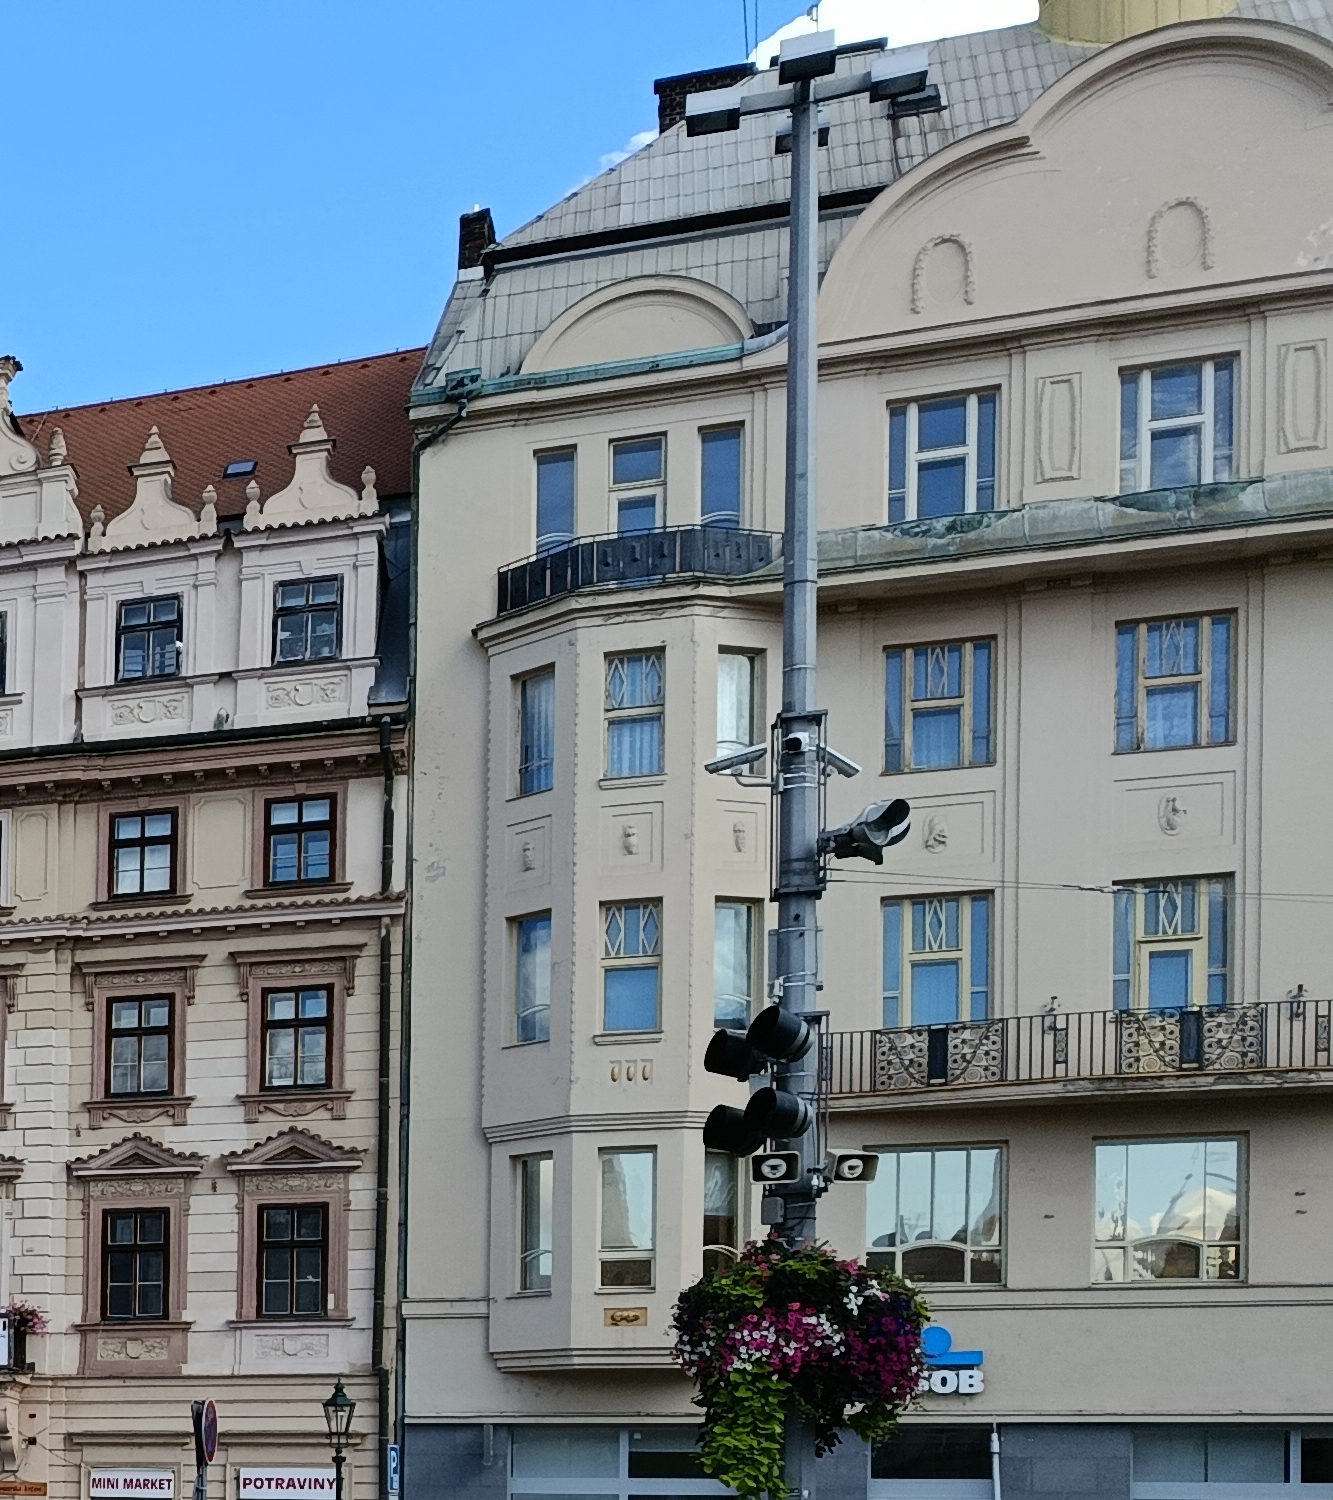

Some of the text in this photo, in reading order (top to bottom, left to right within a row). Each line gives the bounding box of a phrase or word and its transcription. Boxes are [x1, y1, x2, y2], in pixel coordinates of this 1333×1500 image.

[390, 1450, 398, 1477] P
[91, 1477, 173, 1491] MINI MARKET
[242, 1476, 336, 1490] POTRAVINY
